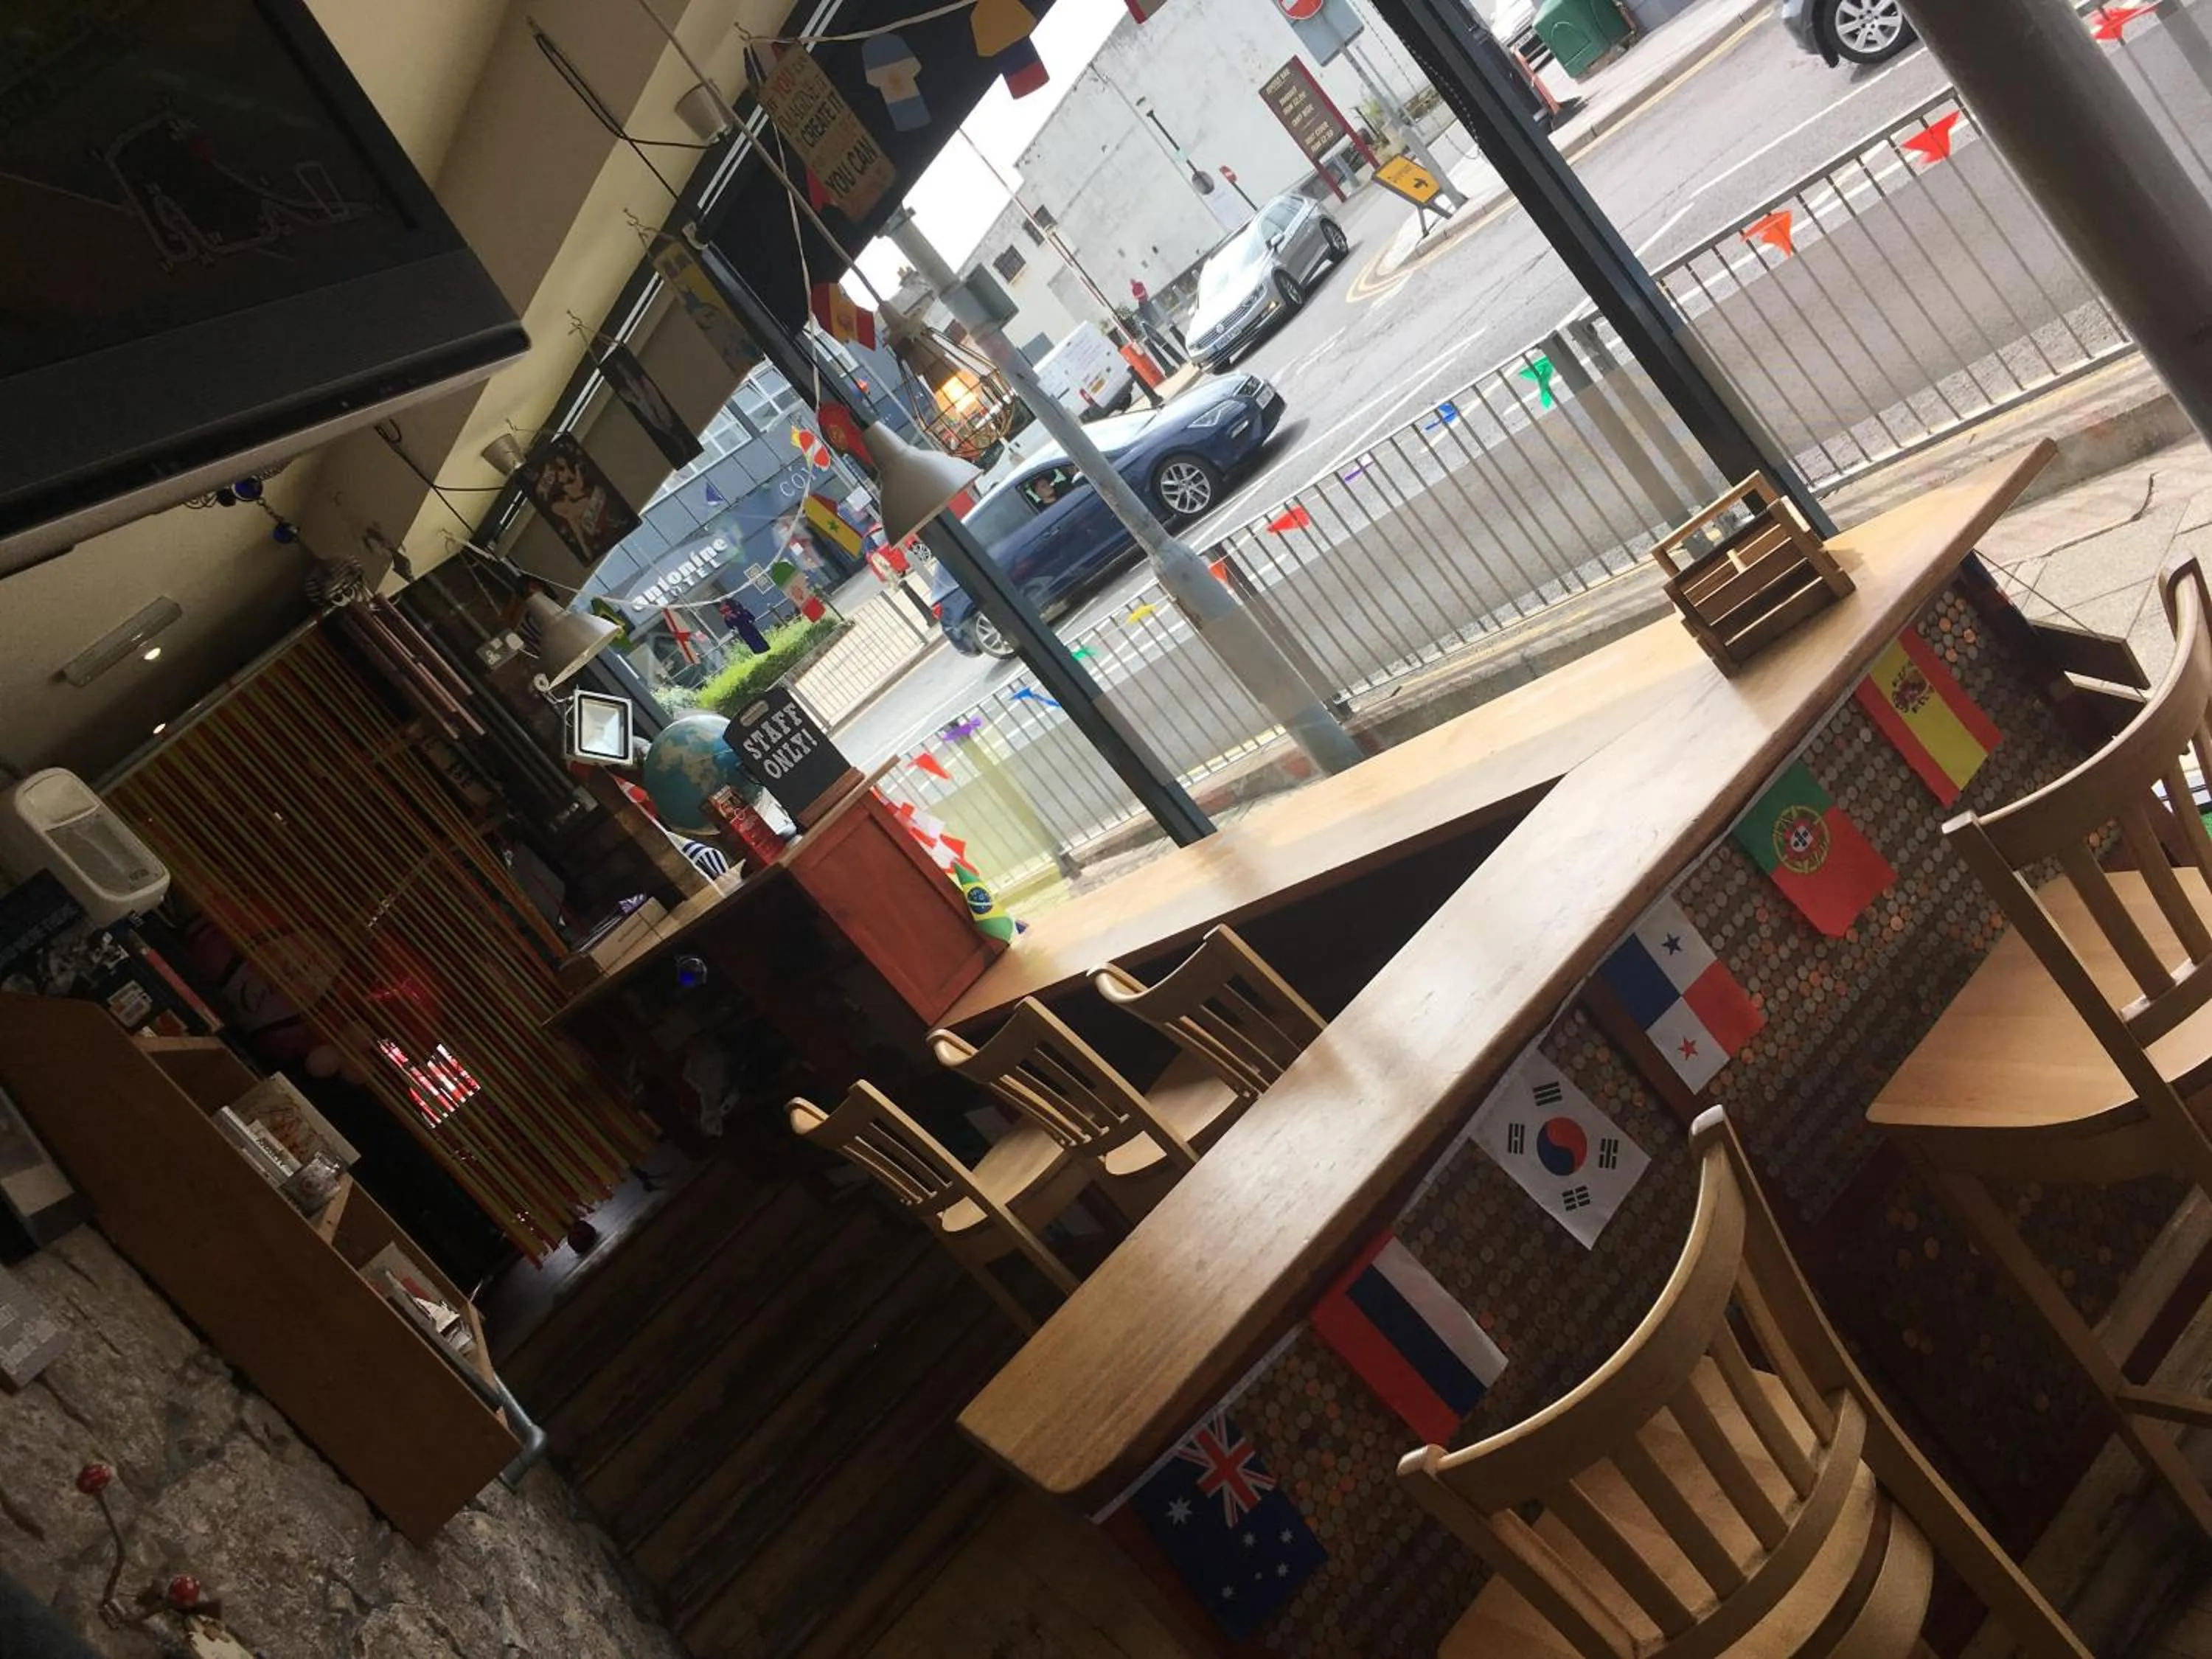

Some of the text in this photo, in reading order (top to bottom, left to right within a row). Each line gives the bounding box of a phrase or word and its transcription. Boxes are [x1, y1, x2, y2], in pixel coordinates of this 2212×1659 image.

[801, 90, 845, 147] CREATE IT
[825, 160, 855, 198] YOU
[846, 135, 879, 175] CAN
[742, 701, 803, 761] STAFF
[763, 727, 818, 779] ONLY!
